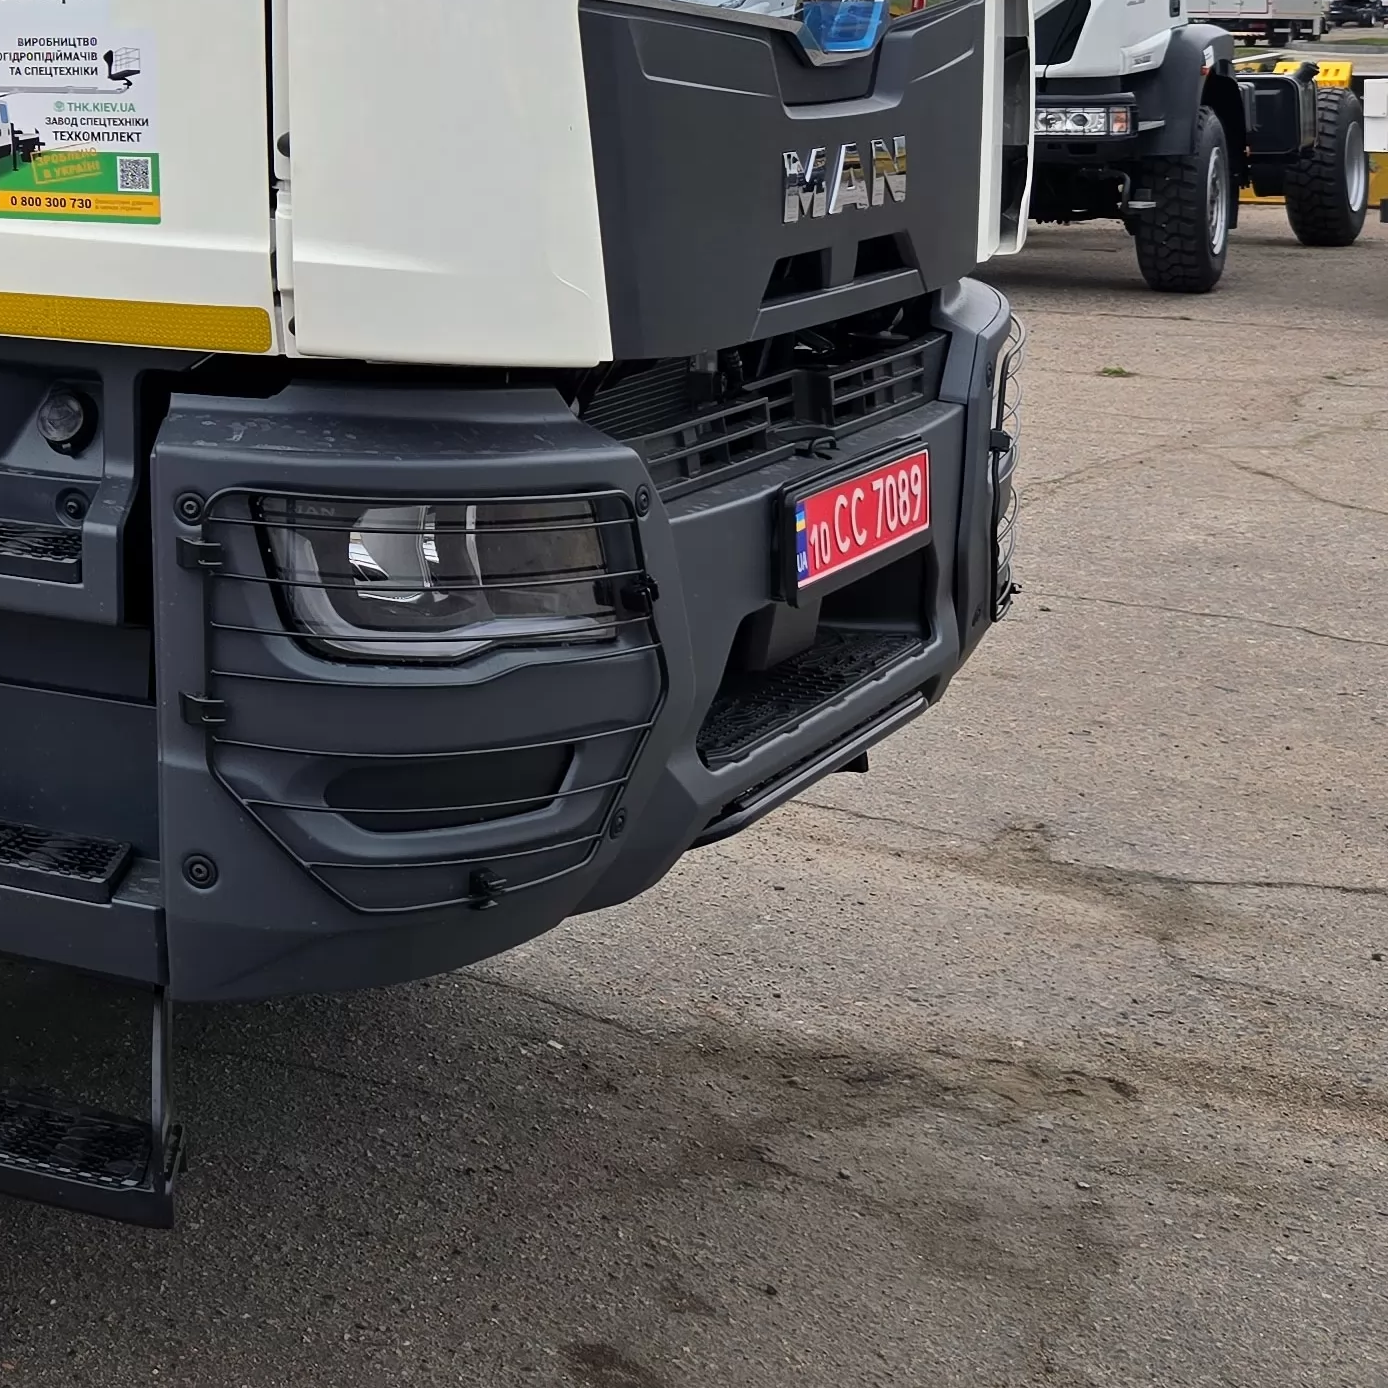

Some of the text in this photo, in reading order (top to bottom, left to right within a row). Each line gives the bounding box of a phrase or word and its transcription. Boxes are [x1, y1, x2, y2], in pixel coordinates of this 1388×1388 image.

[17, 37, 98, 49] ВИРОБНИЦТВО
[9, 66, 99, 77] ТА СПЕЦТЕХНІКИ
[67, 101, 136, 113] THK.KIEV.UA
[45, 116, 149, 128] ЗАВОД СПЕЦТЕХНІКИ
[52, 130, 142, 143] ТЕХКОМПЛЕКТ
[782, 135, 907, 224] MAN
[10, 196, 17, 206] 0
[21, 196, 42, 207] 800
[45, 197, 67, 208] 300
[70, 198, 92, 209] 730
[797, 465, 922, 573] UA 10 CC 7089
